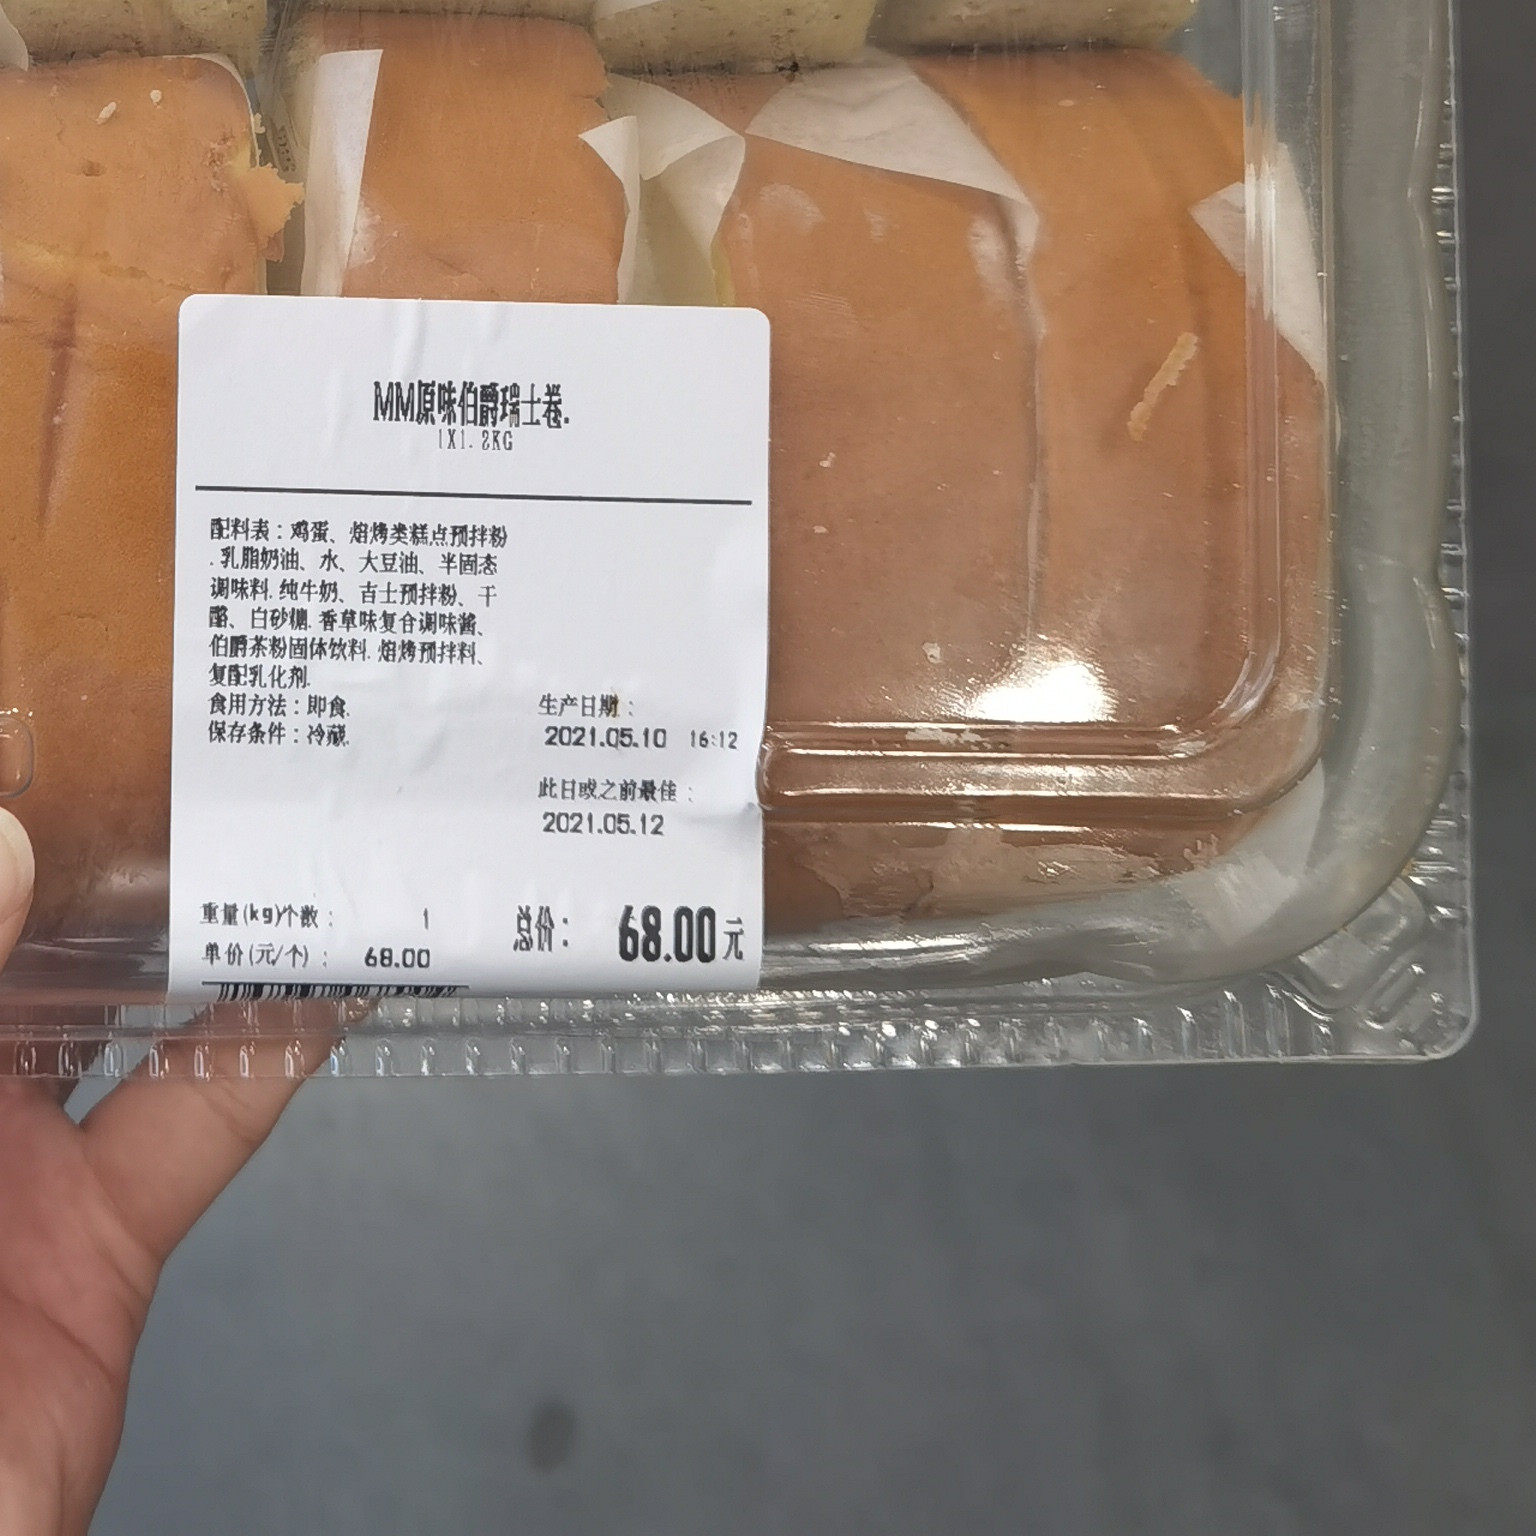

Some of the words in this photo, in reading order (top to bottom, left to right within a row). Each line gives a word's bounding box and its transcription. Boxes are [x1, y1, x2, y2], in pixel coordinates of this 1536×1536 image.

[544, 725, 667, 750] 2021.05.10
[690, 729, 739, 750] 16:12
[542, 811, 664, 836] 2021.05.12
[422, 907, 430, 931] 1
[364, 946, 431, 969] 68.00
